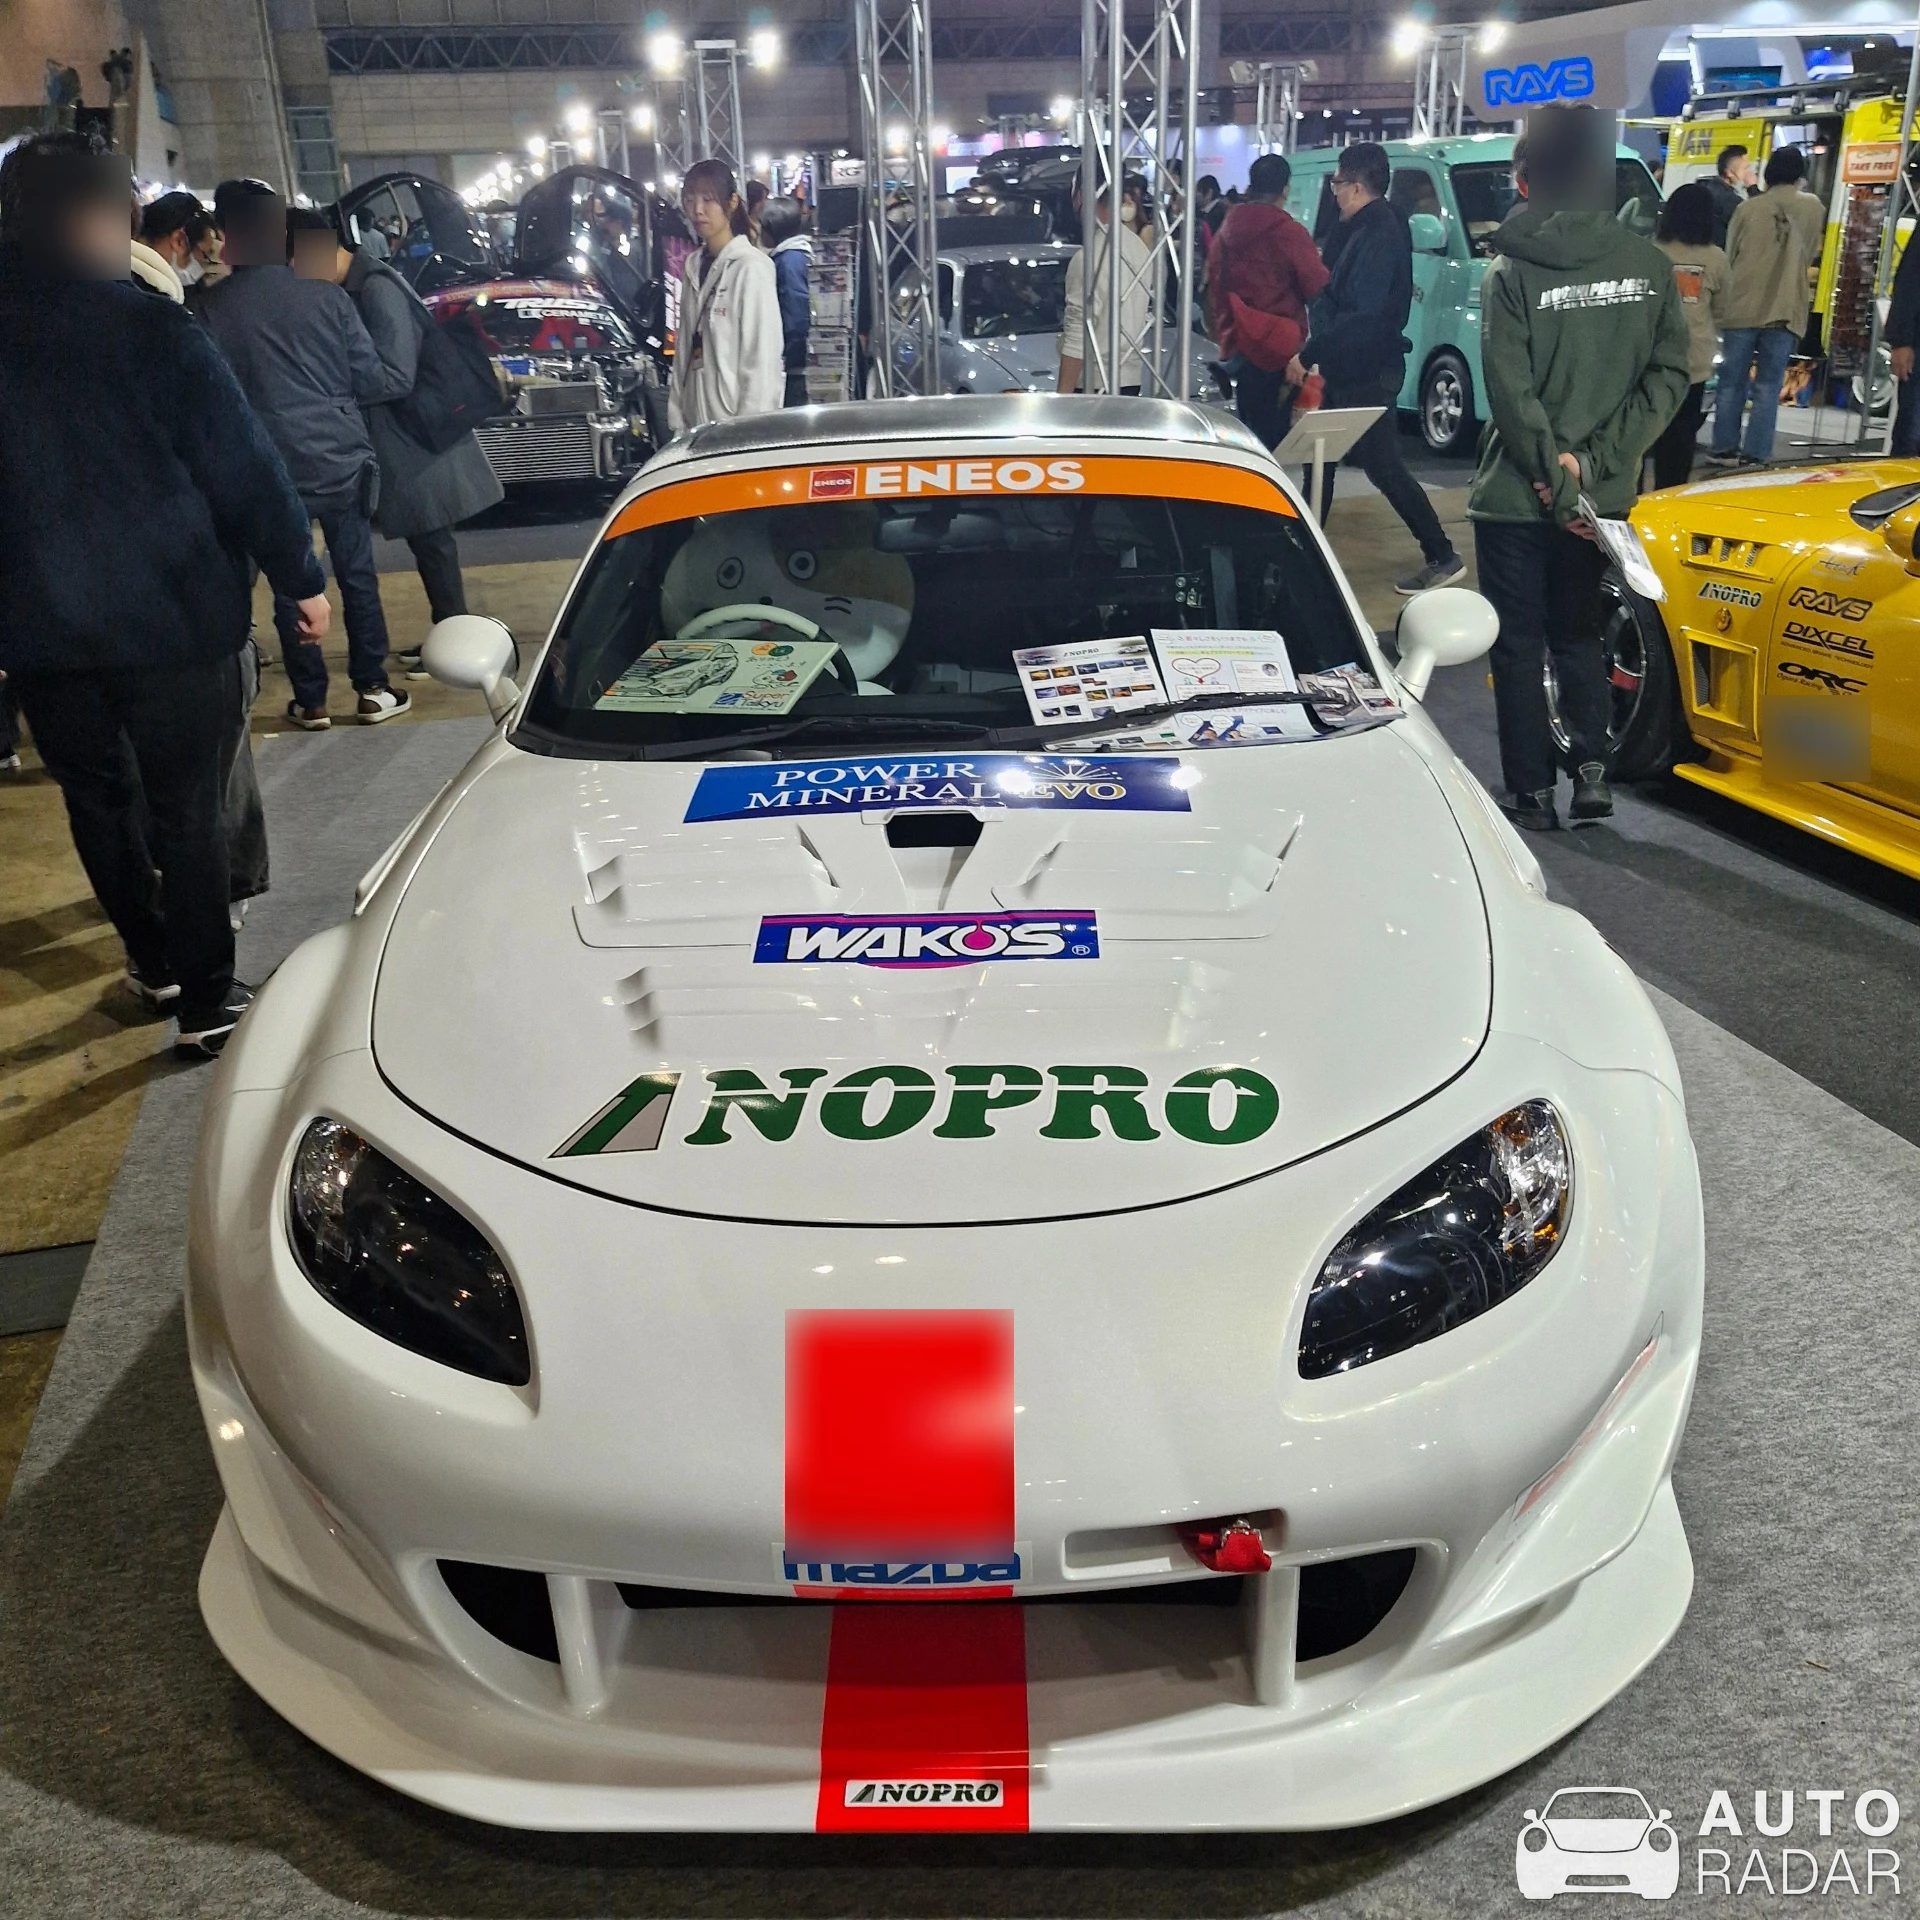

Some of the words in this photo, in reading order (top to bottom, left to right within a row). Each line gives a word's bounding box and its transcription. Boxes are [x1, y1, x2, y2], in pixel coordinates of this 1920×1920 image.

[1486, 58, 1592, 105] RAYS
[1850, 162, 1871, 172] TAKE
[1873, 161, 1895, 170] FREE
[493, 297, 615, 311] TRUST
[813, 478, 853, 488] ENEOS
[865, 461, 1085, 495] ENEOS
[1789, 586, 1873, 621] RAYS
[1784, 621, 1874, 654] DIXCEL
[1778, 661, 1868, 693] ORC
[744, 690, 789, 700] Super
[771, 761, 982, 788] POWER
[744, 782, 1001, 811] MINERAL
[1018, 782, 1127, 801] EVO
[785, 922, 1066, 959] WAKO'S
[684, 1065, 1279, 1146] NOPRO
[878, 1783, 999, 1803] NOPRO
